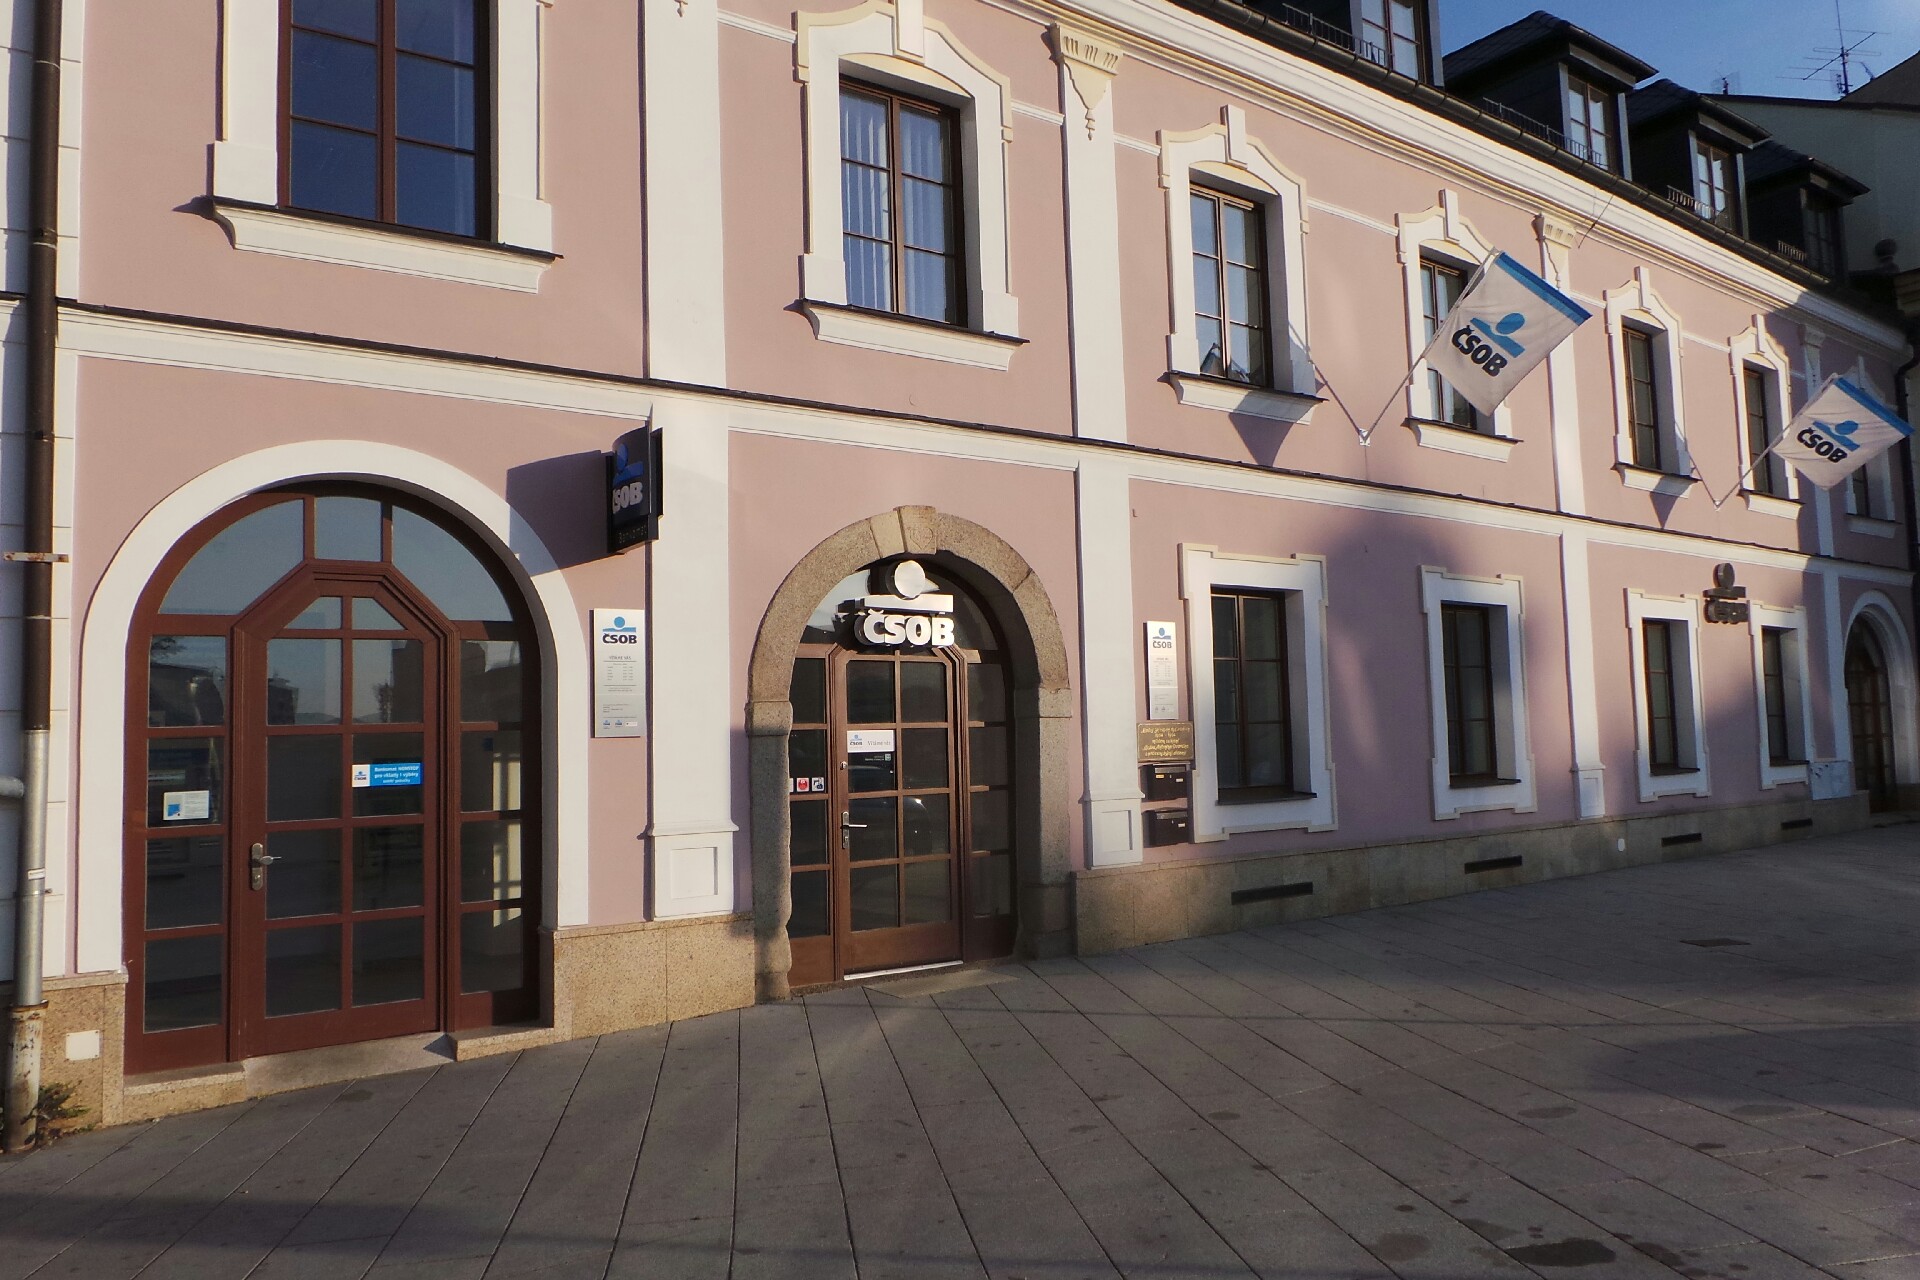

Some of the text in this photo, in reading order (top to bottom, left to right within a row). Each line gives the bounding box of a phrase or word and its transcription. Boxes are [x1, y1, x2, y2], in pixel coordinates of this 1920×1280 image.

[1451, 324, 1508, 378] ČSOB
[1796, 427, 1848, 463] ČSOB
[602, 632, 638, 645] ČSOB
[863, 608, 955, 647] ČSOB
[1152, 639, 1173, 649] ČSOB
